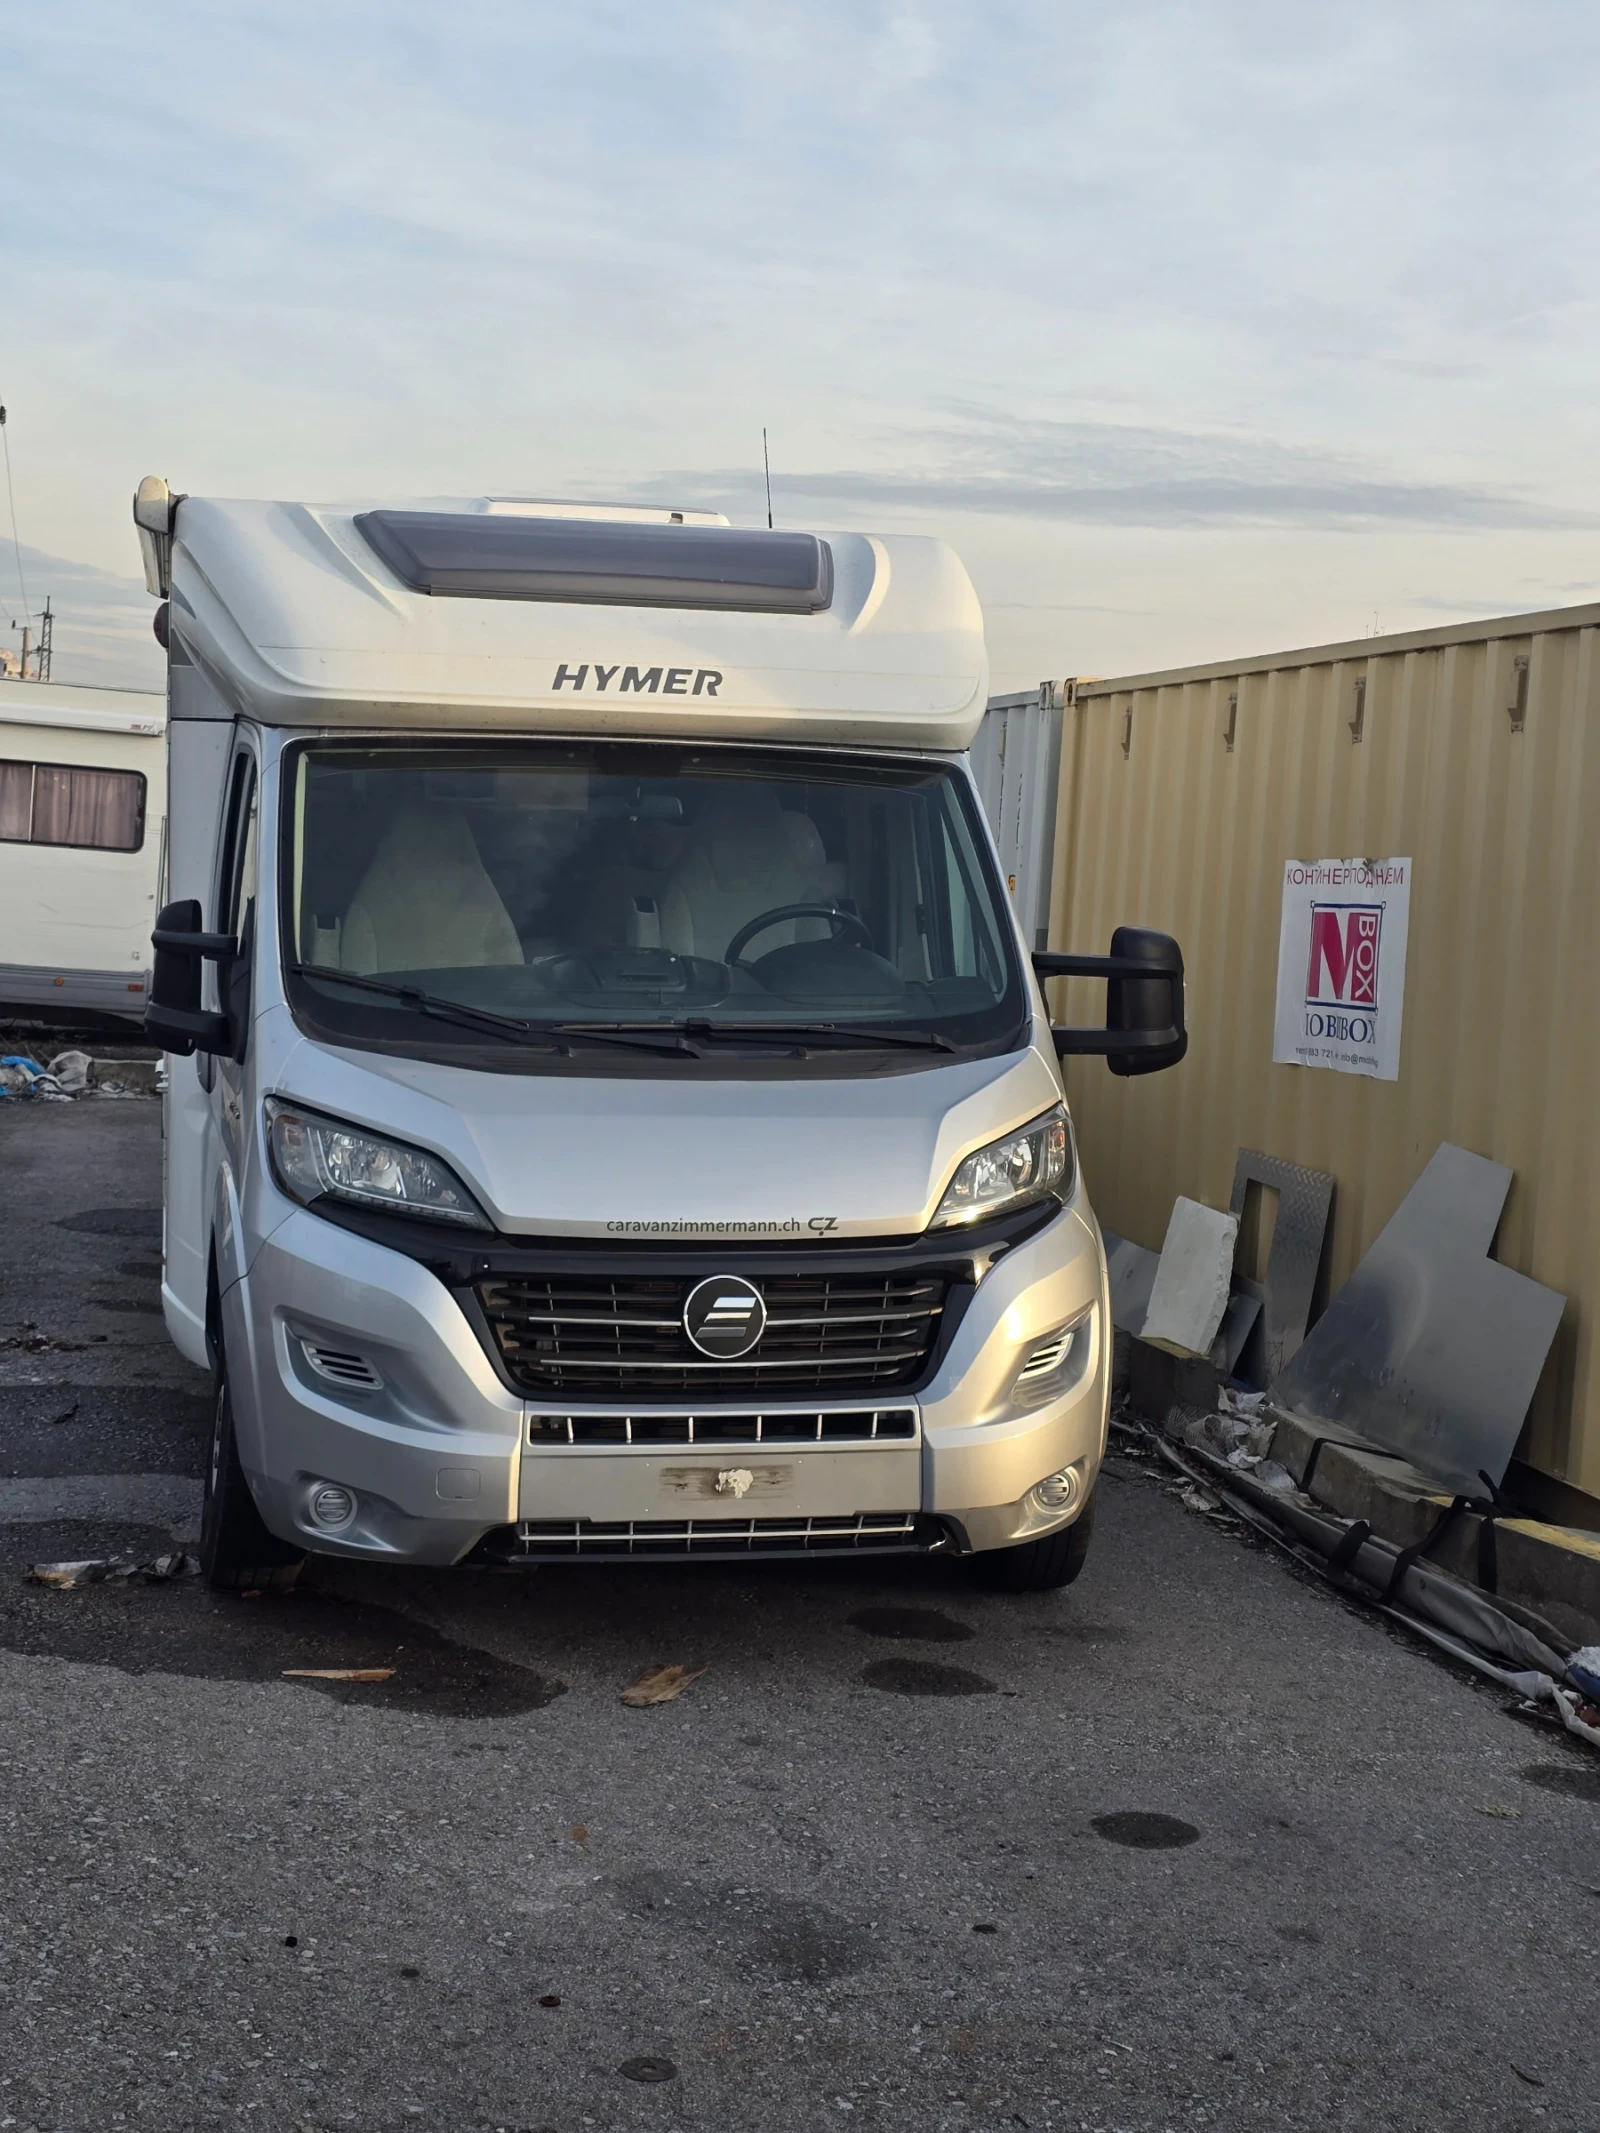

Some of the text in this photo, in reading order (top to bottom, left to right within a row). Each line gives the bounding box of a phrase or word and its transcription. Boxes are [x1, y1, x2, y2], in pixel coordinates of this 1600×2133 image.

[552, 664, 723, 696] HYMER
[1354, 915, 1376, 999] BOX
[606, 1218, 801, 1233] caravanzimmermann.ch
